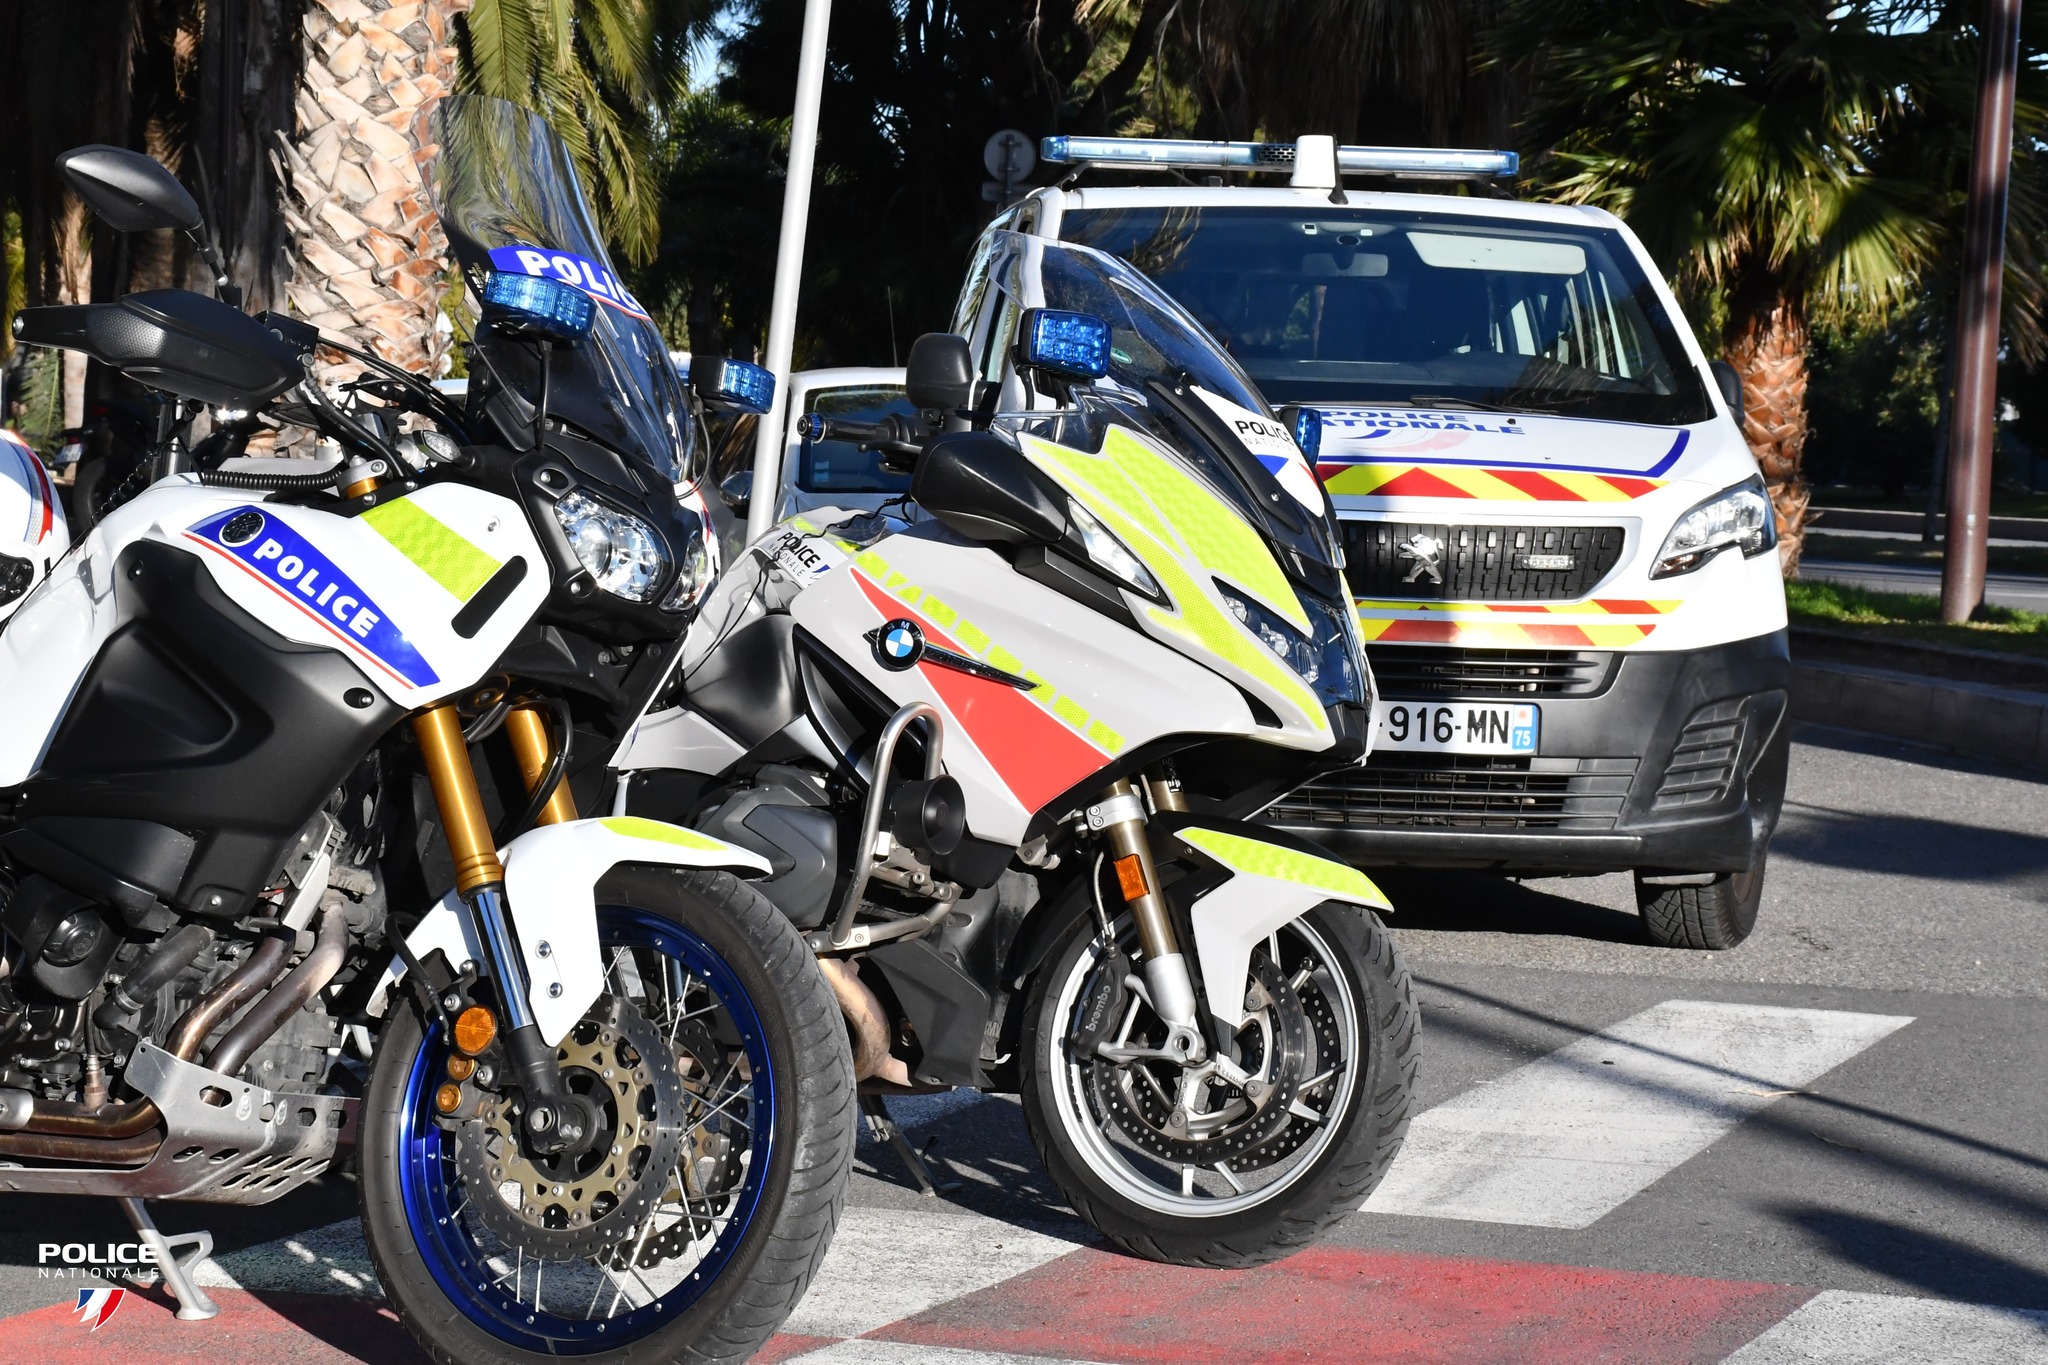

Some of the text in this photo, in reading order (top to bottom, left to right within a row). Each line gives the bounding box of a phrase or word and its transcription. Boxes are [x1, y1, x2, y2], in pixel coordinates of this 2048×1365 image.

[515, 250, 640, 312] POLIC
[1321, 418, 1526, 435] ATIONALE
[767, 543, 806, 577] NAONALE
[776, 531, 822, 569] POLICE
[252, 537, 381, 639] POLICE
[1515, 730, 1531, 747] 75
[1085, 985, 1111, 1032] brembo
